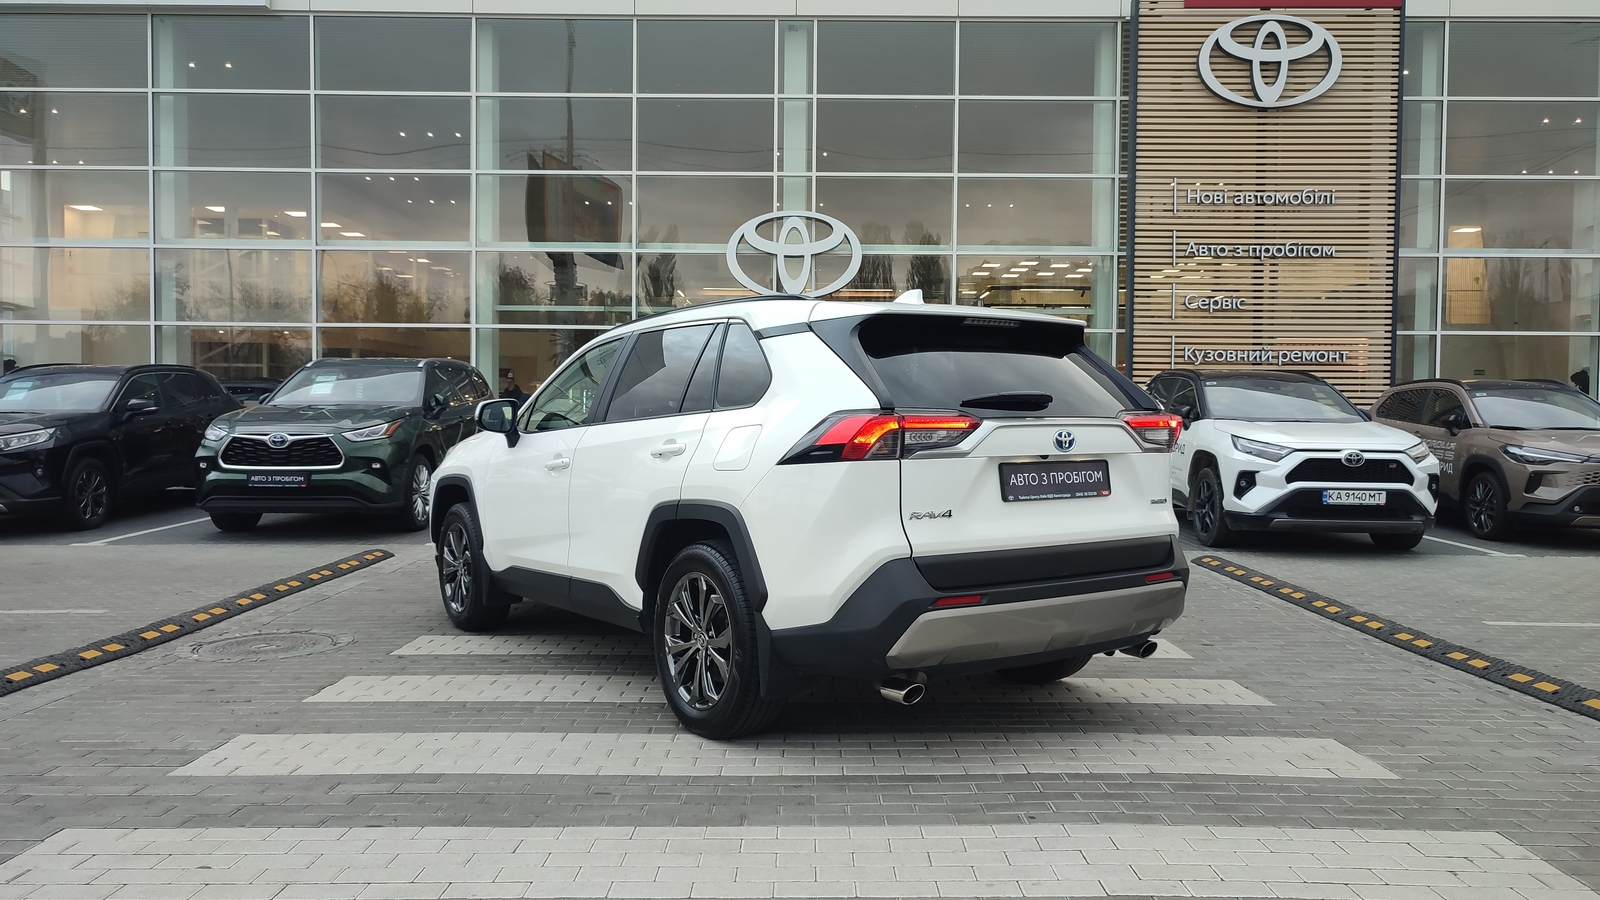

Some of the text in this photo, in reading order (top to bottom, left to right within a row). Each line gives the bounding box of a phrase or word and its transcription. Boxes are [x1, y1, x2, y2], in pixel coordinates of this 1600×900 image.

[1186, 188, 1336, 205] Нові автомобілі
[1185, 241, 1336, 261] Авто з пробігом
[1185, 293, 1246, 313] Сервіс
[1184, 345, 1349, 366] Кузовний ремонт
[1009, 473, 1039, 486] АВТО
[1050, 470, 1103, 484] ПРОБІГОМ
[1344, 491, 1367, 501] 9140
[909, 509, 953, 520] RAV4
